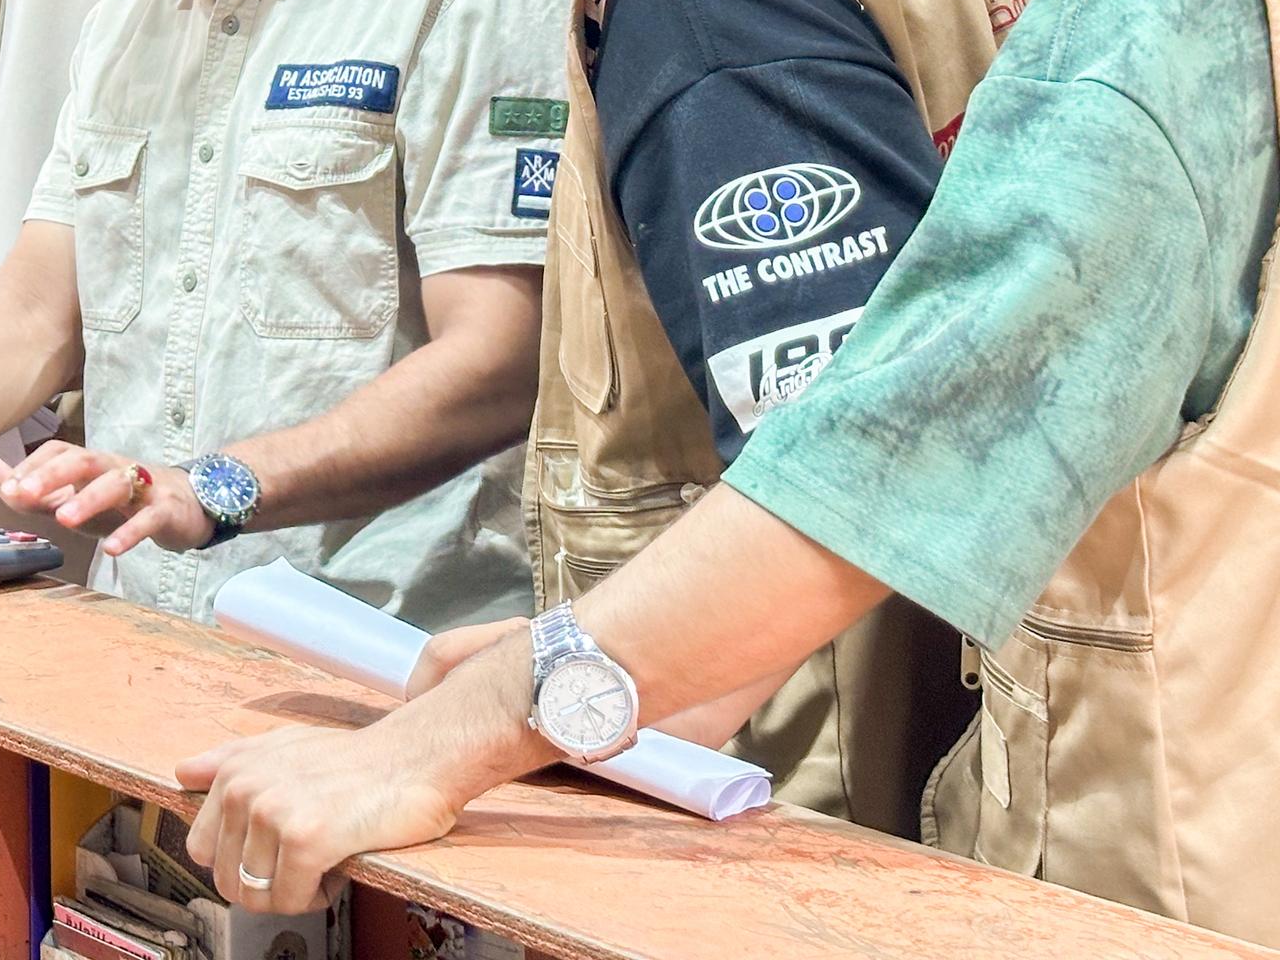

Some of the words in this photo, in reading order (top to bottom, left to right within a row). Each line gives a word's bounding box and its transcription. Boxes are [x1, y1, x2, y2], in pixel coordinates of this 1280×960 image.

[279, 70, 299, 88] PA
[287, 84, 347, 101] ESTABLISHED
[347, 86, 365, 100] 93
[702, 264, 753, 303] THE
[756, 226, 889, 283] CONTRAST
